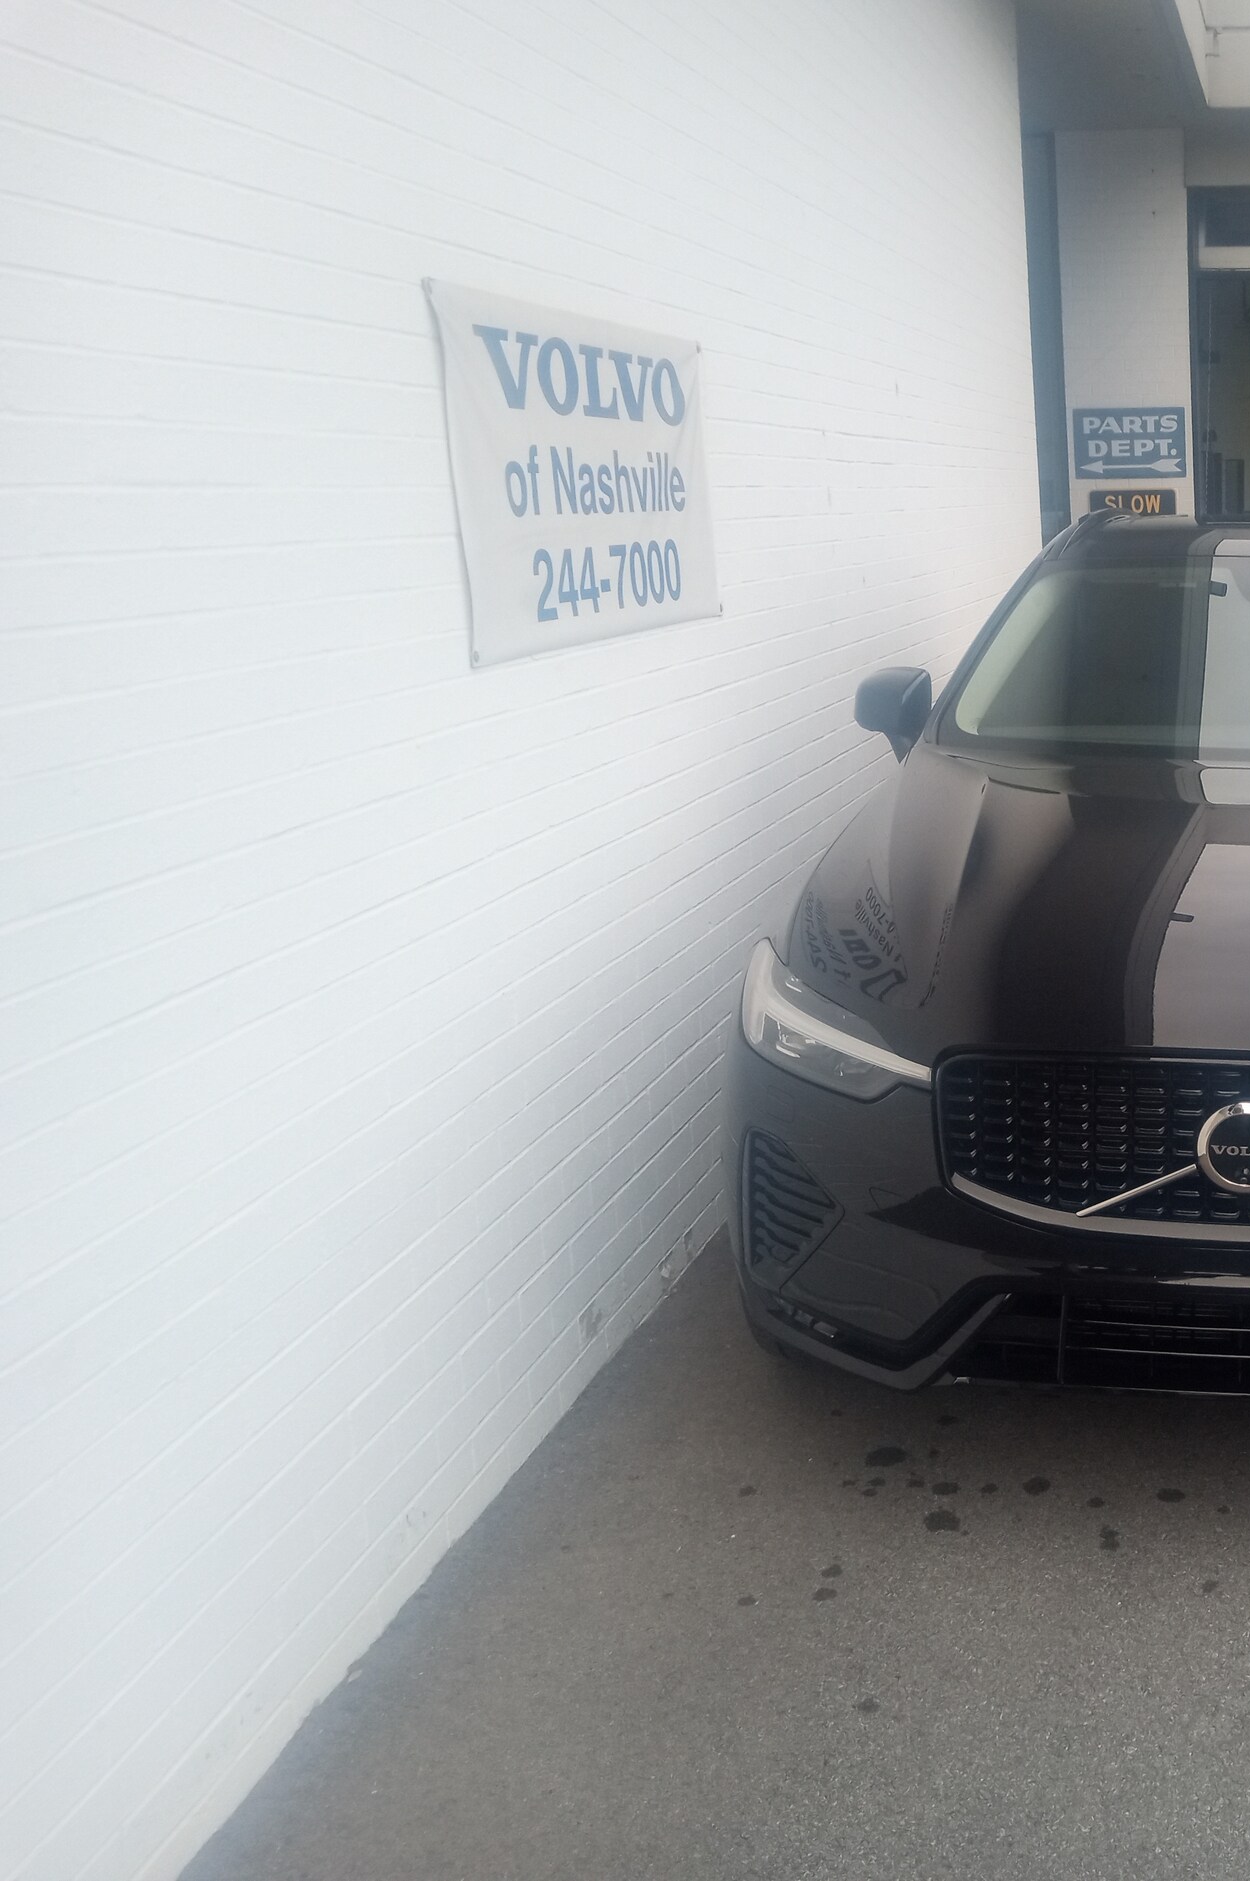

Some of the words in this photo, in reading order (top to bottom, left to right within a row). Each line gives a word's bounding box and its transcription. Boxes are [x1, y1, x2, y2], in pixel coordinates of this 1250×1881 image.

[472, 324, 686, 427] VOLVO
[1082, 415, 1178, 434] PARTS
[1088, 439, 1178, 457] DEPT.
[504, 444, 540, 518] of
[550, 445, 686, 516] Nashville
[533, 538, 681, 623] 244-7000
